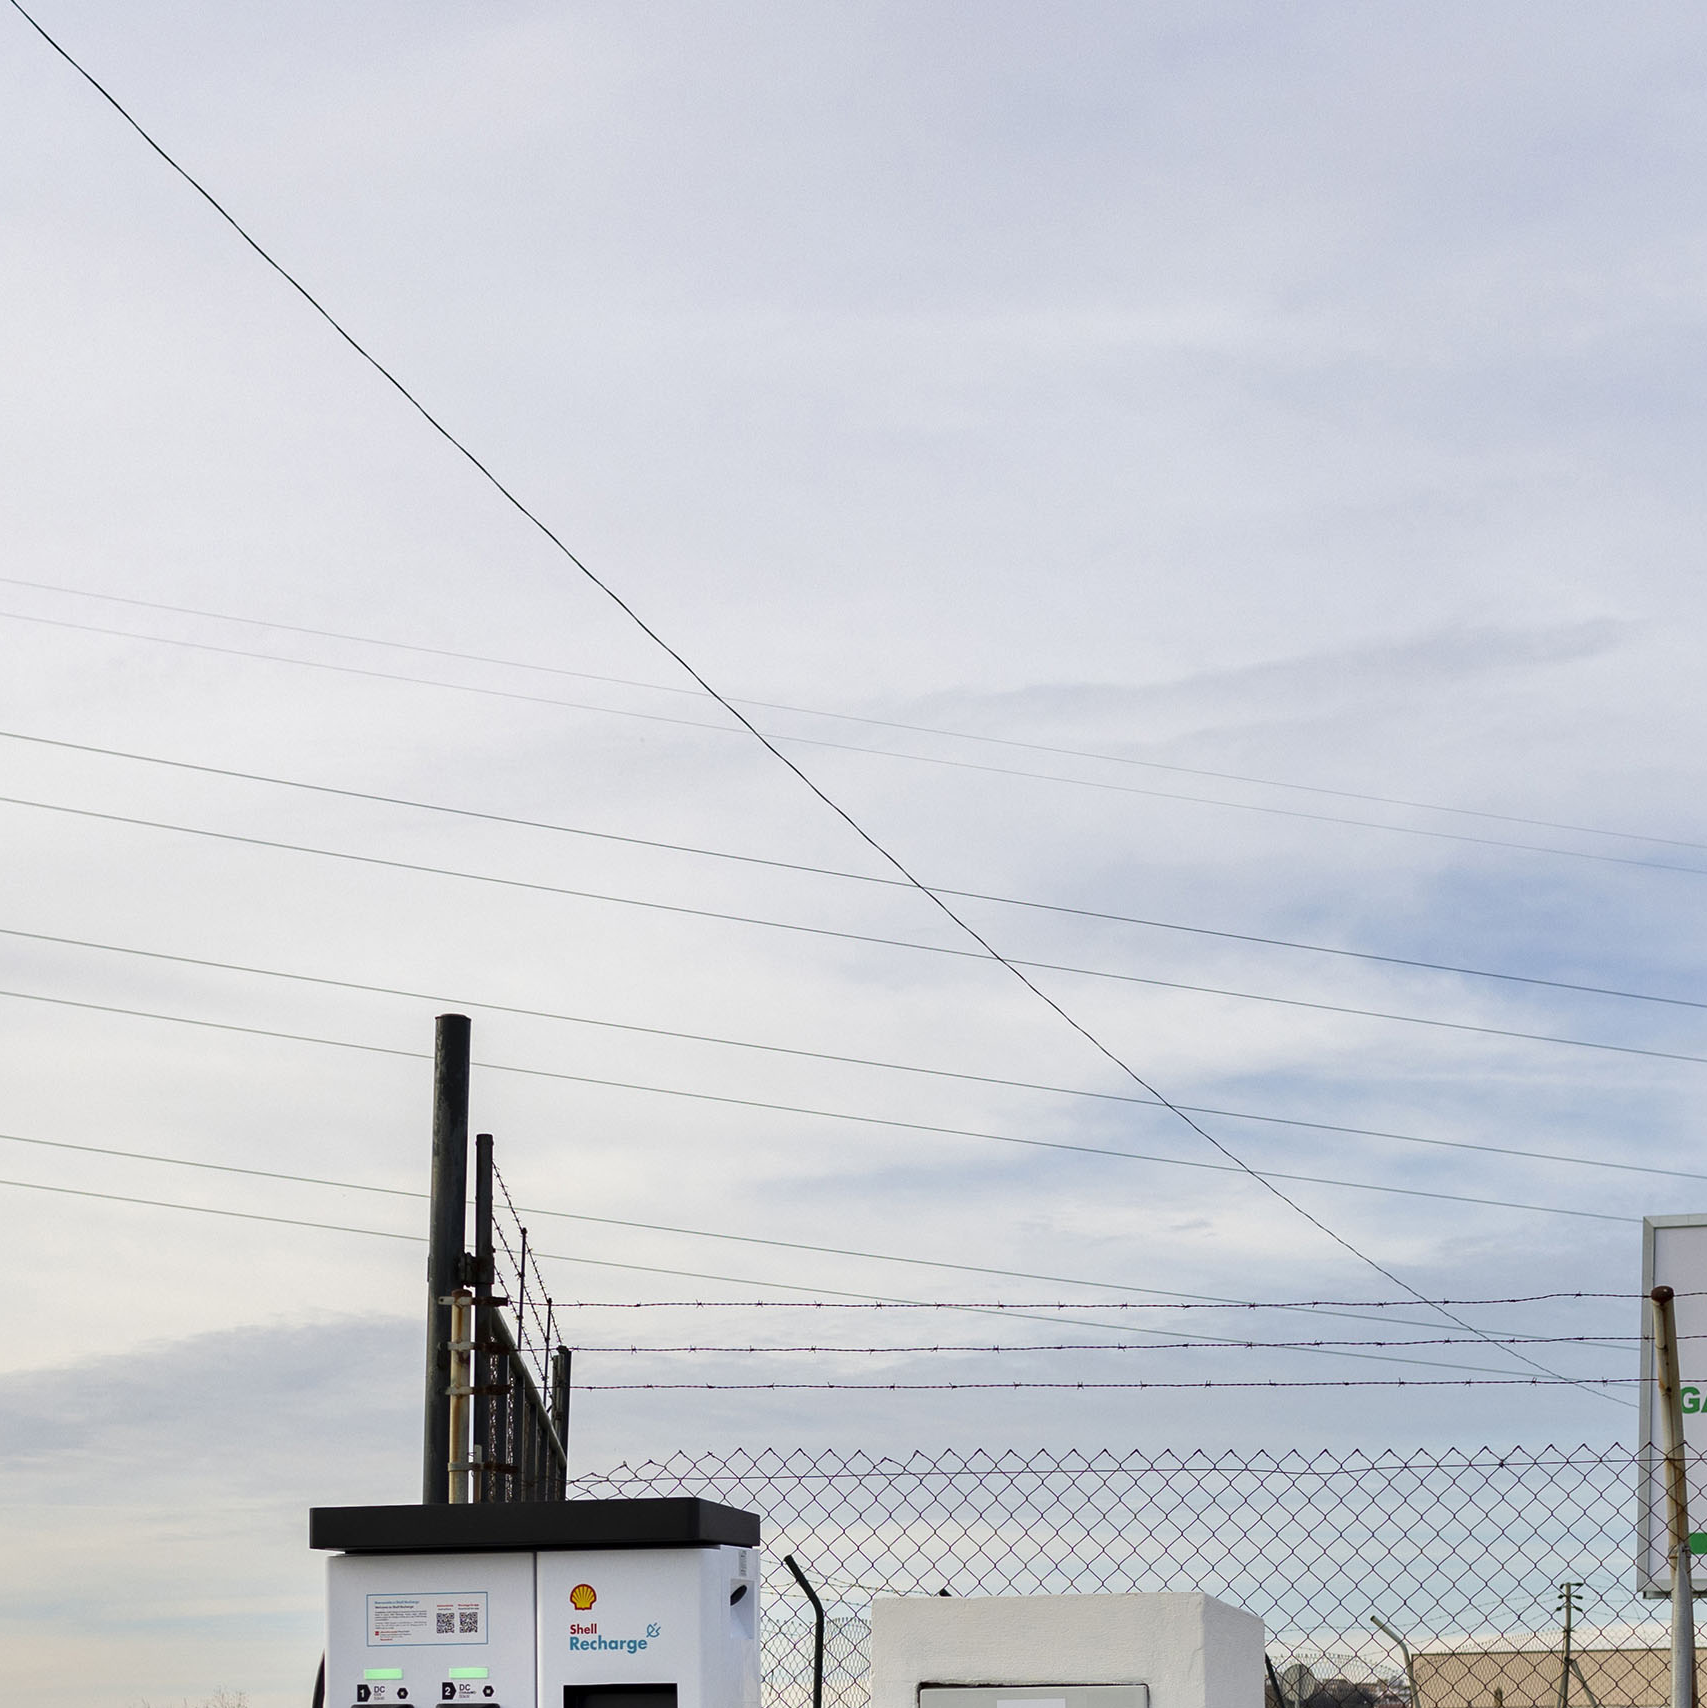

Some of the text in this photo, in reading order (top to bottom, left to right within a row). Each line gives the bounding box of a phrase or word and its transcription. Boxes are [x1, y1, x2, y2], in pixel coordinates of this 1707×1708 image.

[569, 1623, 597, 1635] Shell
[569, 1634, 648, 1654] Recharge
[373, 1685, 386, 1694] DC
[444, 1686, 451, 1696] 2
[459, 1683, 471, 1691] DC
[360, 1689, 365, 1698] 1
